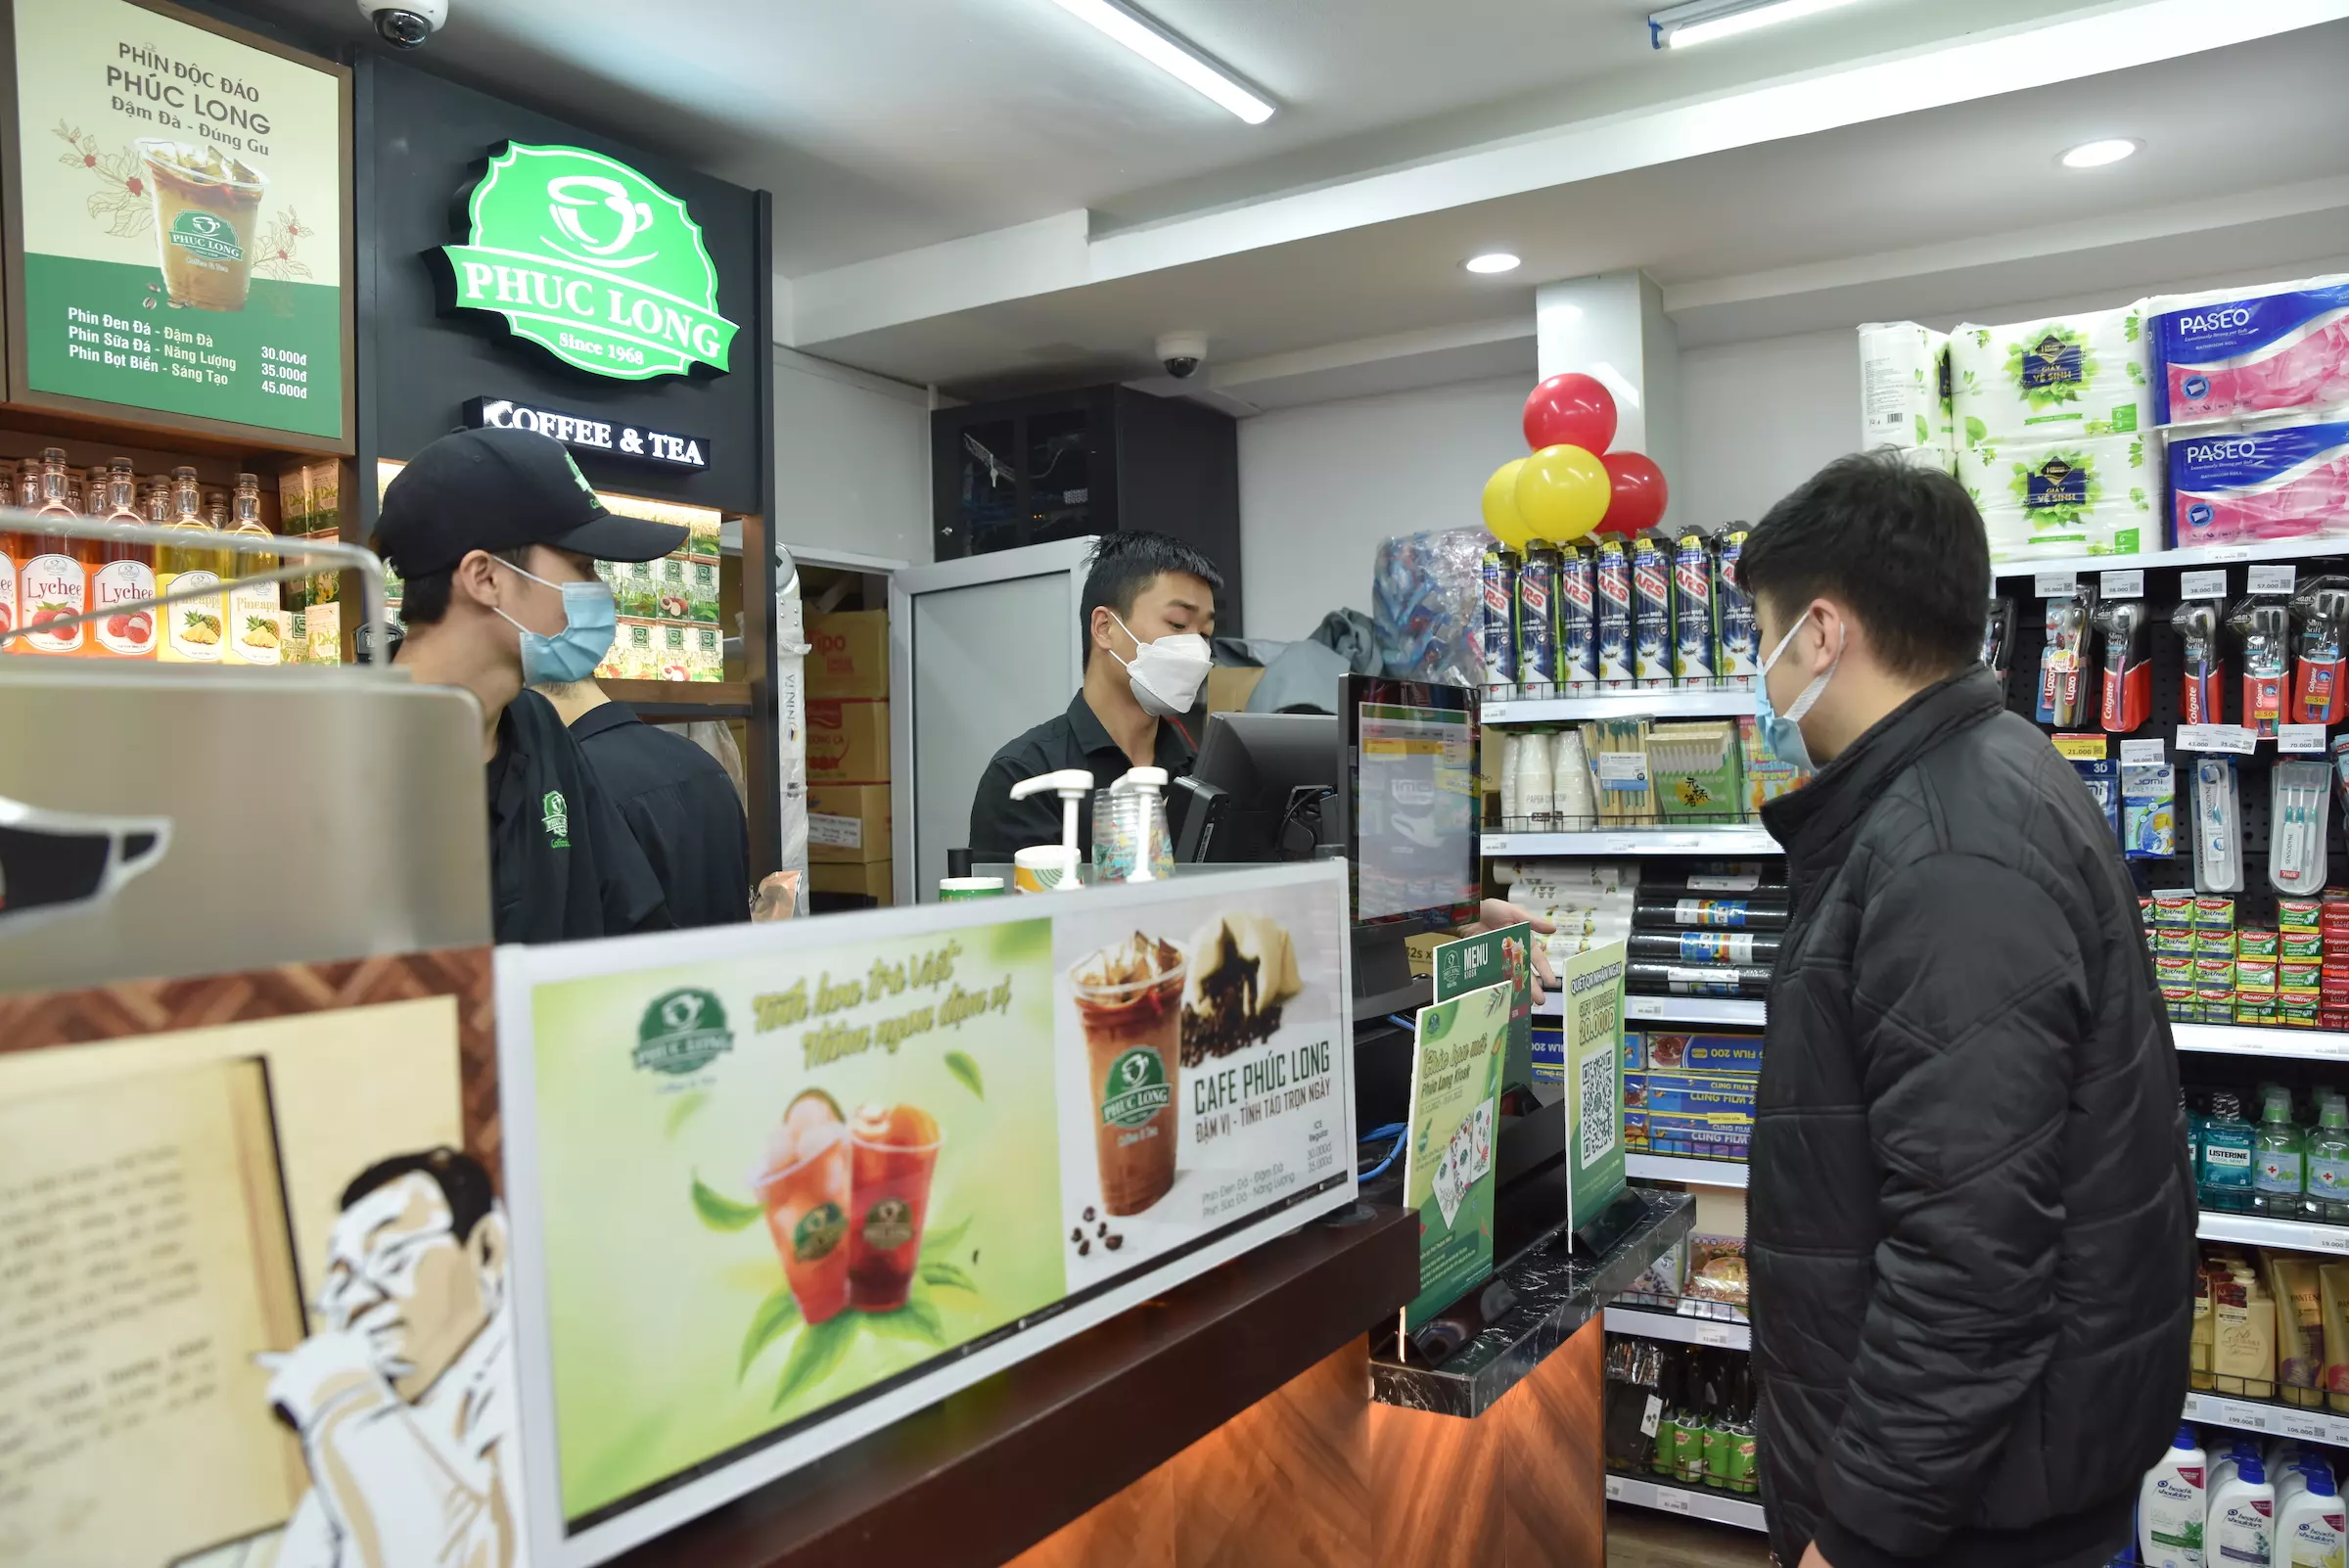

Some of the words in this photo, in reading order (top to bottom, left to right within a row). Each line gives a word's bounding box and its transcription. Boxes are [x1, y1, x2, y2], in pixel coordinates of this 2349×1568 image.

[119, 42, 168, 73] PHIN
[174, 62, 214, 87] ĐỘC
[220, 77, 259, 103] ĐÁO
[107, 65, 184, 108] PHÚC
[195, 94, 271, 135] LONG
[112, 96, 152, 120] Đậm
[159, 111, 181, 129] Đà
[199, 122, 242, 151] Đúng
[248, 139, 269, 157] Gu
[172, 234, 206, 247] PHUC
[207, 241, 240, 257] LONG
[462, 261, 594, 316] PHUC
[608, 288, 721, 359] LONG
[2180, 308, 2250, 336] PASEO
[69, 306, 98, 325] Phin
[102, 313, 129, 332] Đen
[133, 319, 151, 336] Đá
[163, 326, 193, 345] Đậm
[197, 333, 213, 348] Đà
[69, 325, 99, 344] Phin
[104, 332, 129, 349] Sữa
[133, 337, 151, 353] Đá
[164, 344, 196, 364] Năng
[200, 350, 236, 372] Lượng
[260, 346, 307, 367] 30.000đ
[559, 332, 604, 355] Since
[608, 344, 644, 366] 1968
[69, 344, 99, 362] Phin
[104, 349, 126, 369] Bọt
[129, 355, 159, 373] Biển
[171, 362, 203, 383] Sáng
[207, 369, 228, 386] Tạo
[261, 362, 307, 383] 35.000đ
[261, 380, 307, 399] 45.000đ
[489, 403, 612, 449] COFFEE
[620, 428, 644, 455] &
[648, 431, 705, 466] TEA
[2187, 439, 2255, 464] PASEO
[27, 577, 82, 599] Lychee
[102, 582, 154, 603] Lychee
[2065, 675, 2077, 701] Lipzo
[2308, 668, 2317, 693] Colgate
[2103, 681, 2114, 719] Colgate
[2094, 763, 2108, 773] 3D
[2285, 834, 2294, 865] SENSODYNE
[1463, 943, 1489, 971] MENU
[1194, 1069, 1237, 1115] CAFE
[1243, 1050, 1286, 1099] PHÚC
[1292, 1040, 1330, 1083] LONG
[1690, 1092, 1720, 1102] CLING
[1691, 1131, 1722, 1142] CLING
[1725, 1135, 1747, 1144] FILM
[2208, 1149, 2247, 1160] LISTERINE
[2158, 1489, 2191, 1499] shoulders
[2228, 1517, 2262, 1529] shoulders
[2297, 1532, 2335, 1544] shoulders
